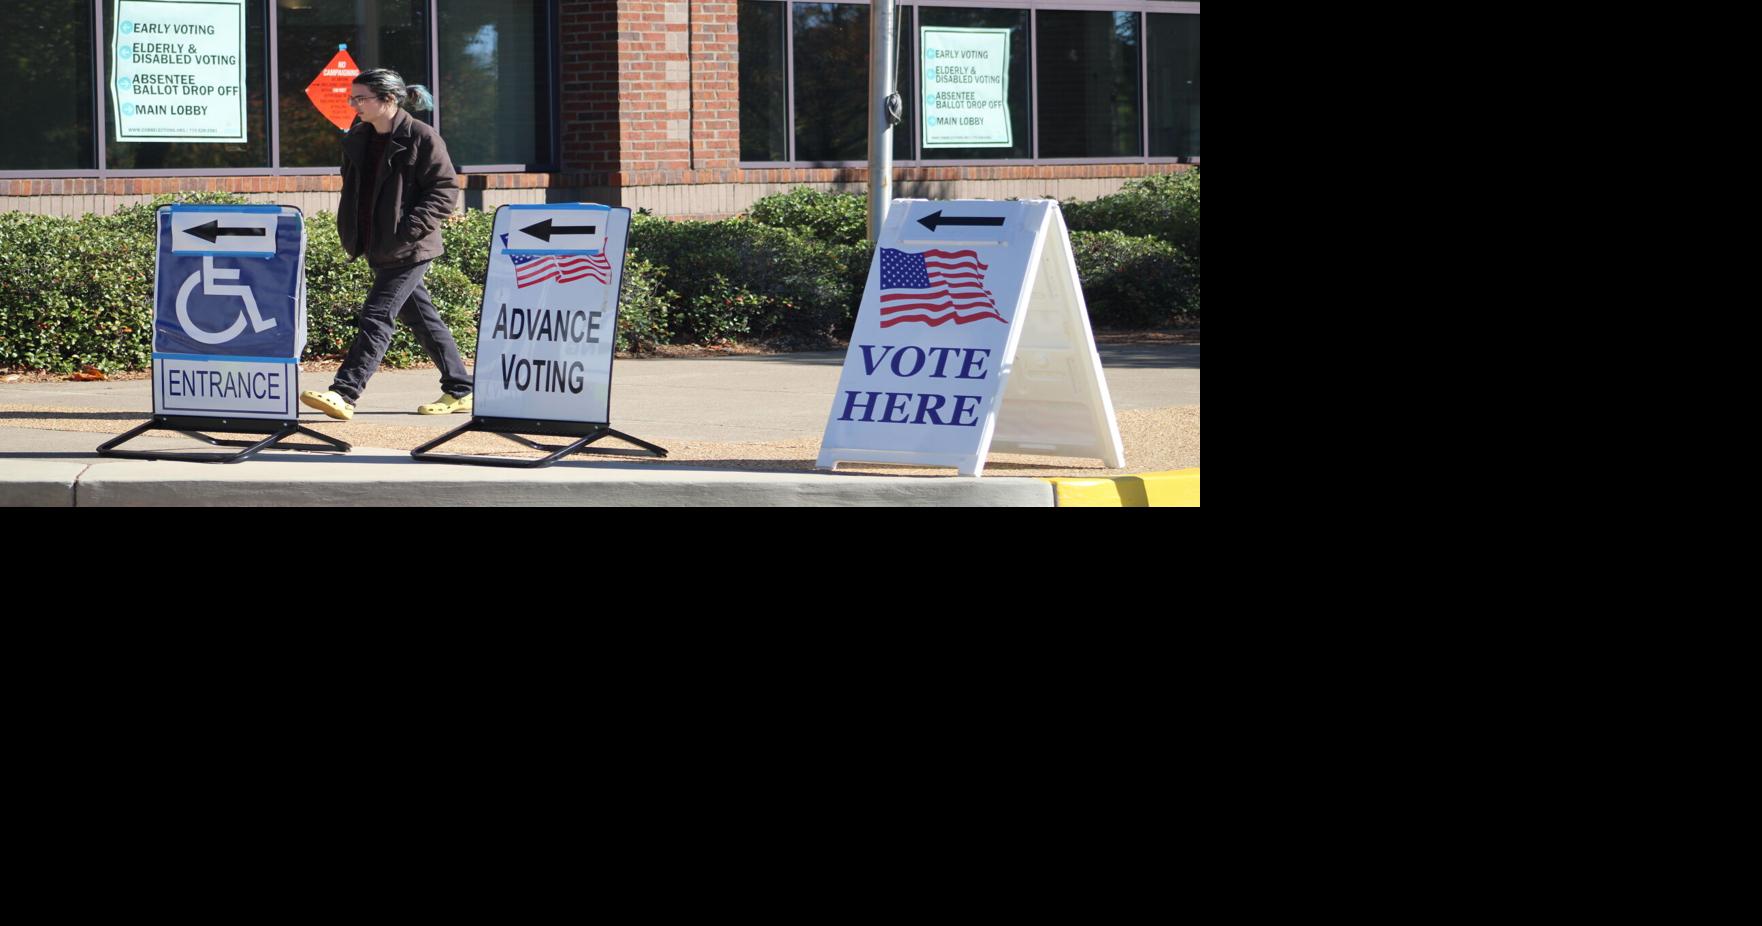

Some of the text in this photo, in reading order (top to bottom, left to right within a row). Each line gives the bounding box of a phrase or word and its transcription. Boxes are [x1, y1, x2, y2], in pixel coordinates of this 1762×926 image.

[133, 23, 215, 35] EARLY VOTING
[132, 42, 197, 54] ELDERLY &
[132, 53, 236, 65] DISABLED VOTING
[935, 50, 989, 59] EARLY VOTING
[935, 66, 969, 75] ELDERLY
[132, 74, 196, 85] ABSENTEE
[935, 75, 1000, 84] DISABLED VOTING
[133, 85, 239, 96] BALLOT DROP OFF
[935, 91, 975, 100] ABSENTEE
[935, 100, 1002, 109] BALLOT DROP OFF
[135, 105, 208, 116] MAIN LOBBY
[936, 117, 984, 126] MAIN LOBBY
[492, 303, 602, 344] ADVANCE
[858, 344, 992, 380] VOTE
[501, 353, 585, 394] VOTING
[168, 369, 281, 400] ENTRANCE
[836, 390, 983, 427] HERE
